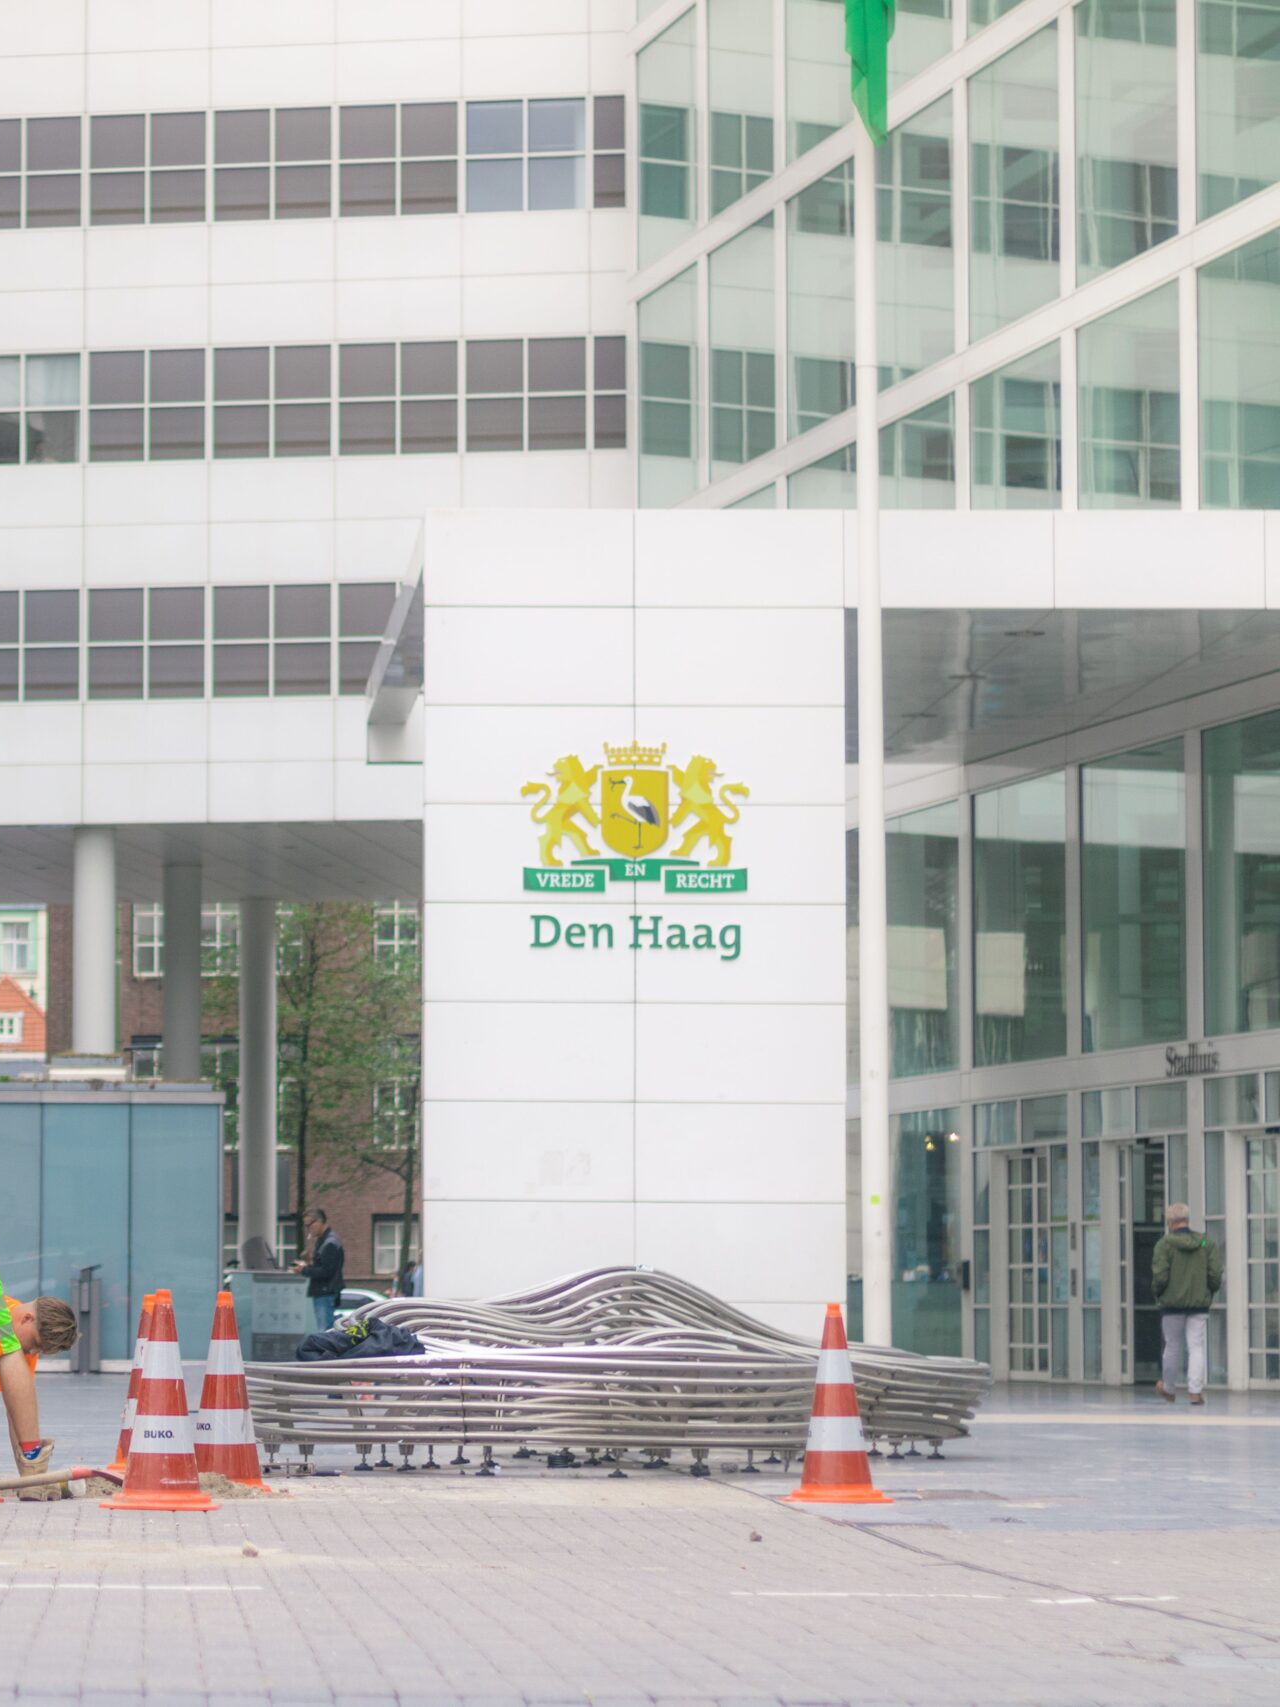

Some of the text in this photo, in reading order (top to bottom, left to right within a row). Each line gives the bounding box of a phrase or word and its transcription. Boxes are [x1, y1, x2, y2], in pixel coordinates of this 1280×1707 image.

[536, 863, 735, 888] VREDE EN RECHT
[530, 915, 742, 961] Den Haag
[1165, 1041, 1220, 1077] Stadhuis
